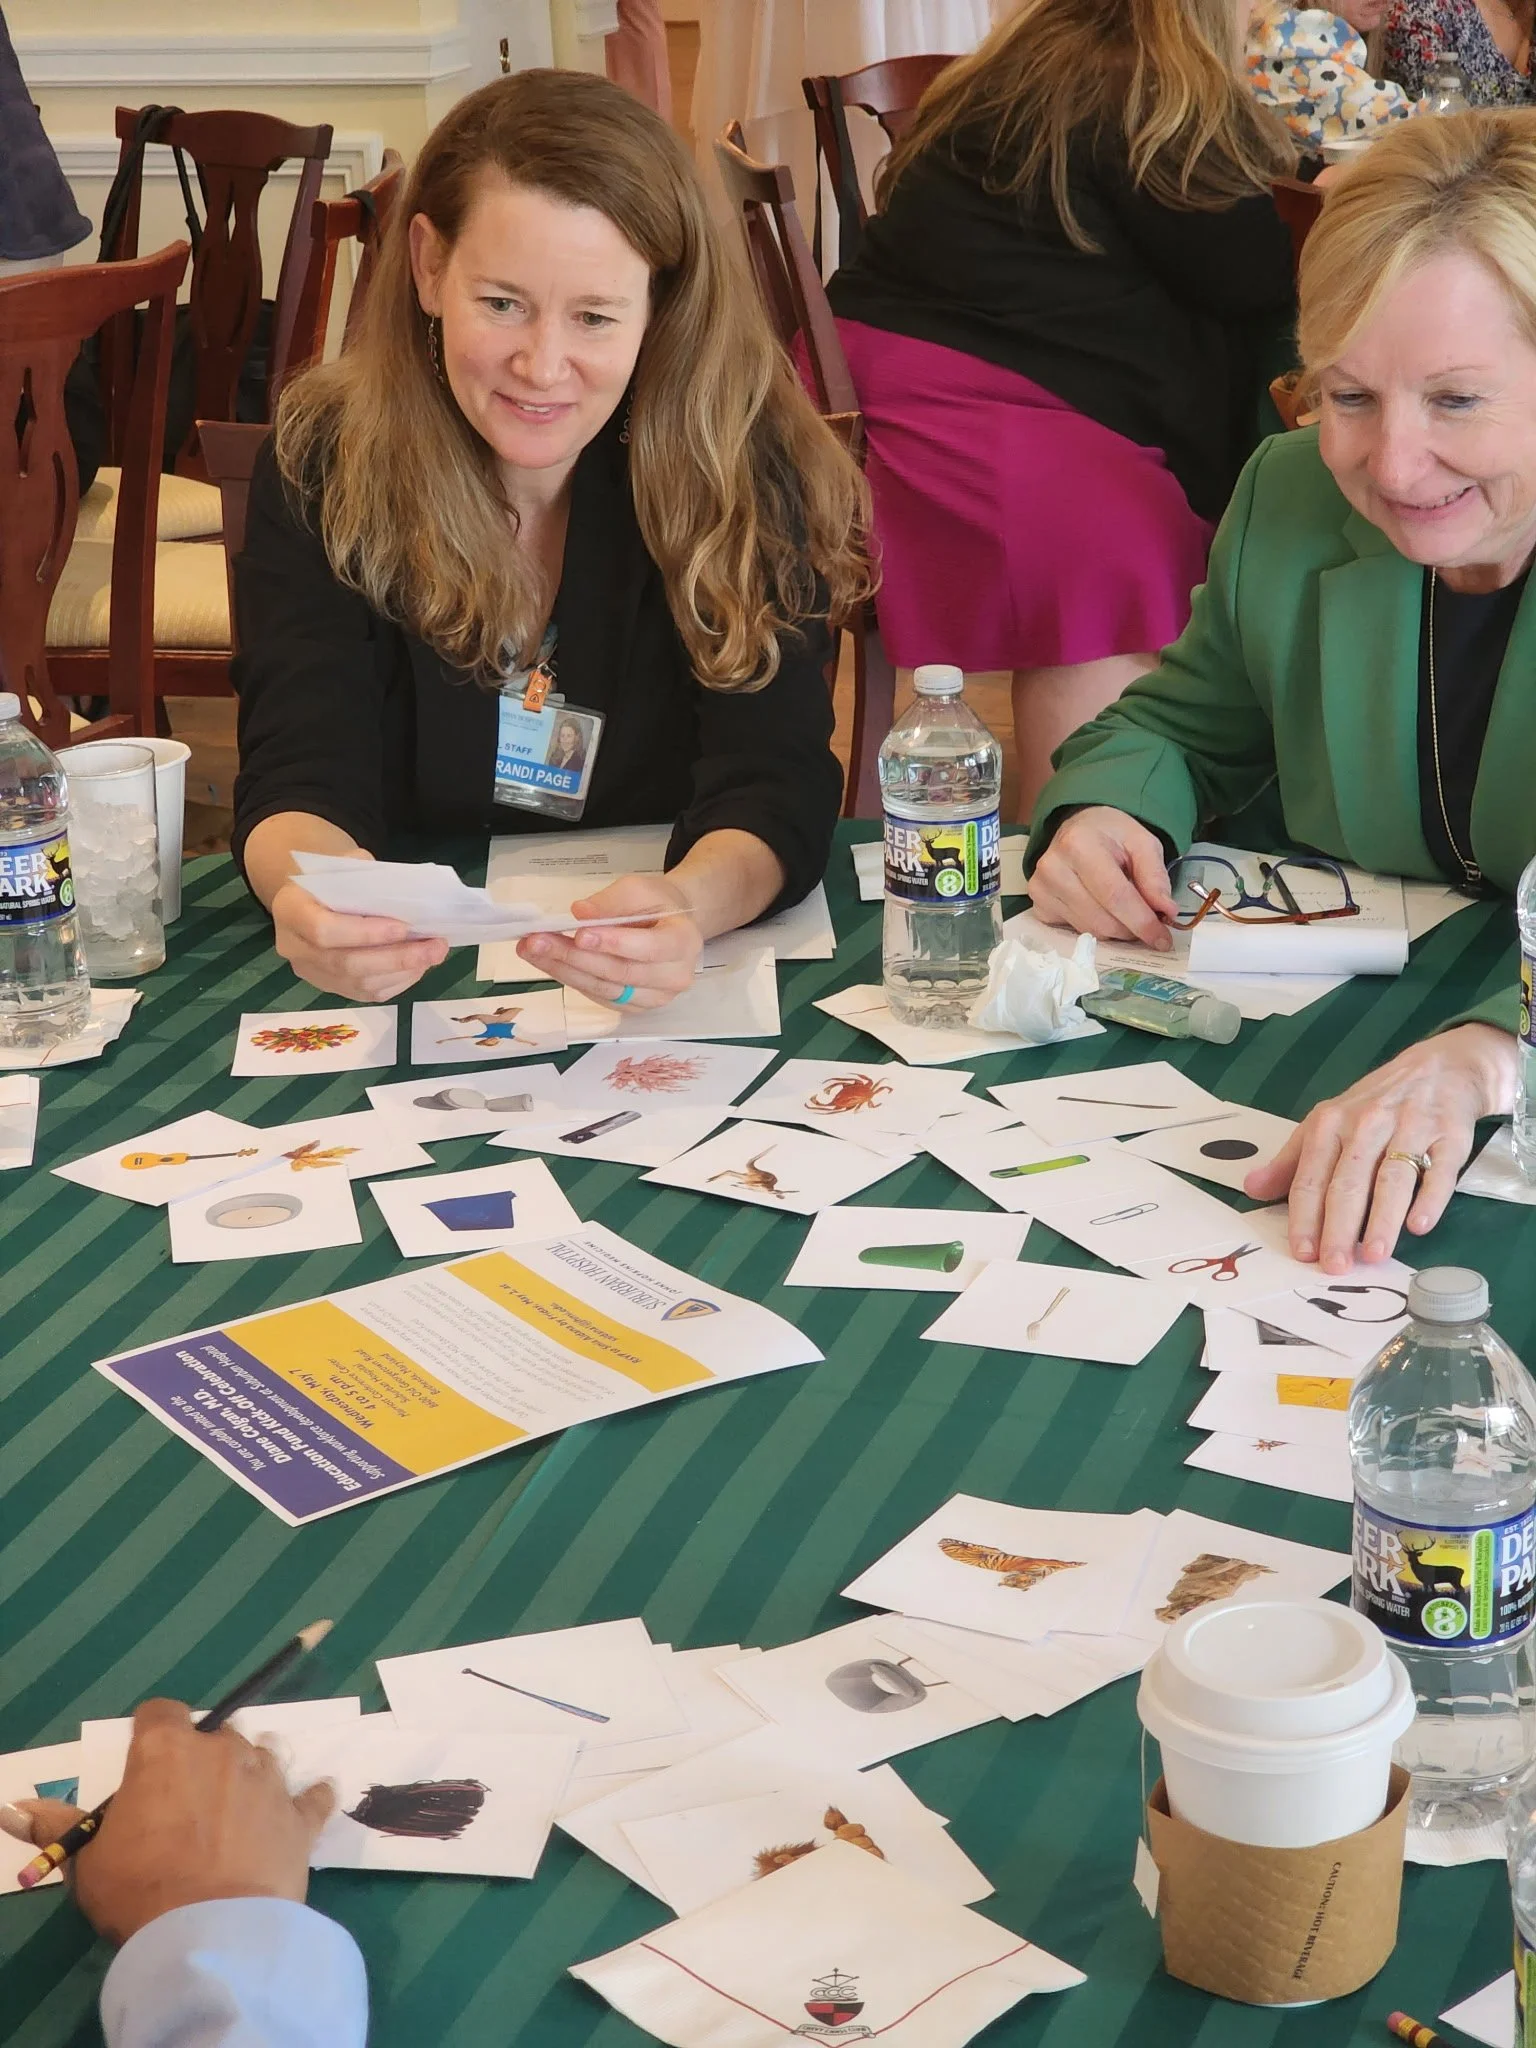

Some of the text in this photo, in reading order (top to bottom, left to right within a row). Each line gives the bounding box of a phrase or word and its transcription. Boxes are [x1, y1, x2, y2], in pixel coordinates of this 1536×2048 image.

[504, 742, 533, 756] STAFF
[535, 769, 572, 789] PAGE
[884, 820, 922, 852] EER
[884, 842, 925, 873] ARK
[545, 1241, 667, 1309] SUBURBAN HOSPITAL
[584, 1241, 681, 1294] JOHNS HOPKINS MEDICINE
[515, 1294, 533, 1304] May
[555, 1318, 568, 1326] by
[199, 1345, 235, 1366] Hospital
[352, 1348, 374, 1361] Road
[378, 1352, 412, 1374] Maryland
[616, 1353, 642, 1363] RSVP
[229, 1364, 265, 1389] Suburban
[298, 1373, 322, 1389] May
[328, 1374, 355, 1389] p.m.
[352, 1363, 411, 1403] Suburban Hospital
[371, 1360, 410, 1388] Georgetown
[170, 1395, 187, 1406] the
[355, 1395, 370, 1404] to
[405, 1387, 422, 1396] Old
[266, 1393, 314, 1425] development
[319, 1387, 374, 1429] Wednesday,
[175, 1350, 362, 1491] Education Fund Kick-Off Celebration
[184, 1411, 216, 1429] invited
[193, 1388, 292, 1463] Diane Colgan, M.D.
[208, 1427, 242, 1448] cordially
[309, 1425, 347, 1451] workforce
[236, 1447, 254, 1458] are
[248, 1458, 266, 1471] You
[341, 1449, 385, 1479] Supporting
[1386, 1600, 1411, 1619] WATER
[1500, 1603, 1517, 1616] 100%
[1293, 1861, 1342, 1980] CAUTION: HOT BEVERAGE
